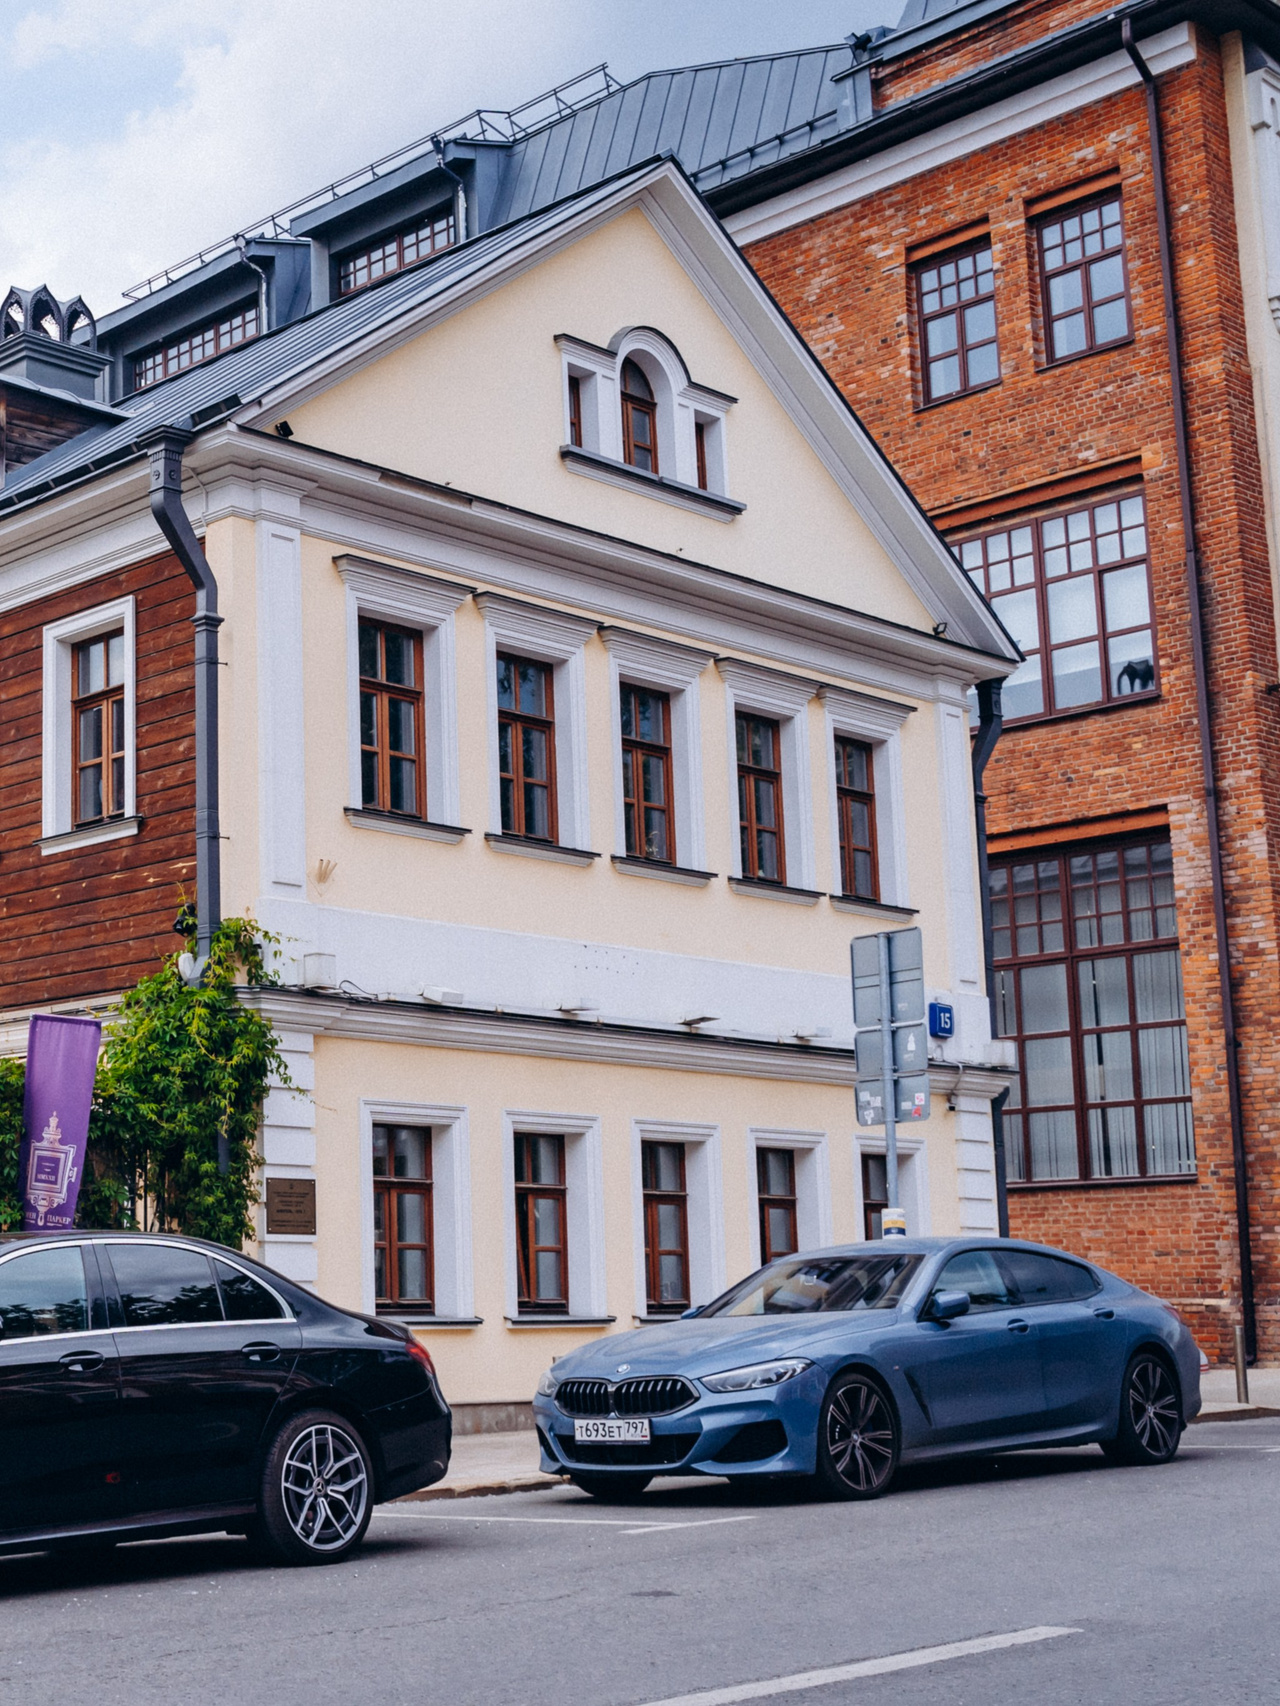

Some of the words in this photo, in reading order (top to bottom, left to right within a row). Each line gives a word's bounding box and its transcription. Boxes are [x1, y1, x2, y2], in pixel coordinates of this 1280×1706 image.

[940, 1012, 951, 1028] 15
[47, 1214, 71, 1225] ПАРКЕР
[579, 1423, 623, 1438] Т693ЕТ
[625, 1421, 645, 1434] 797
